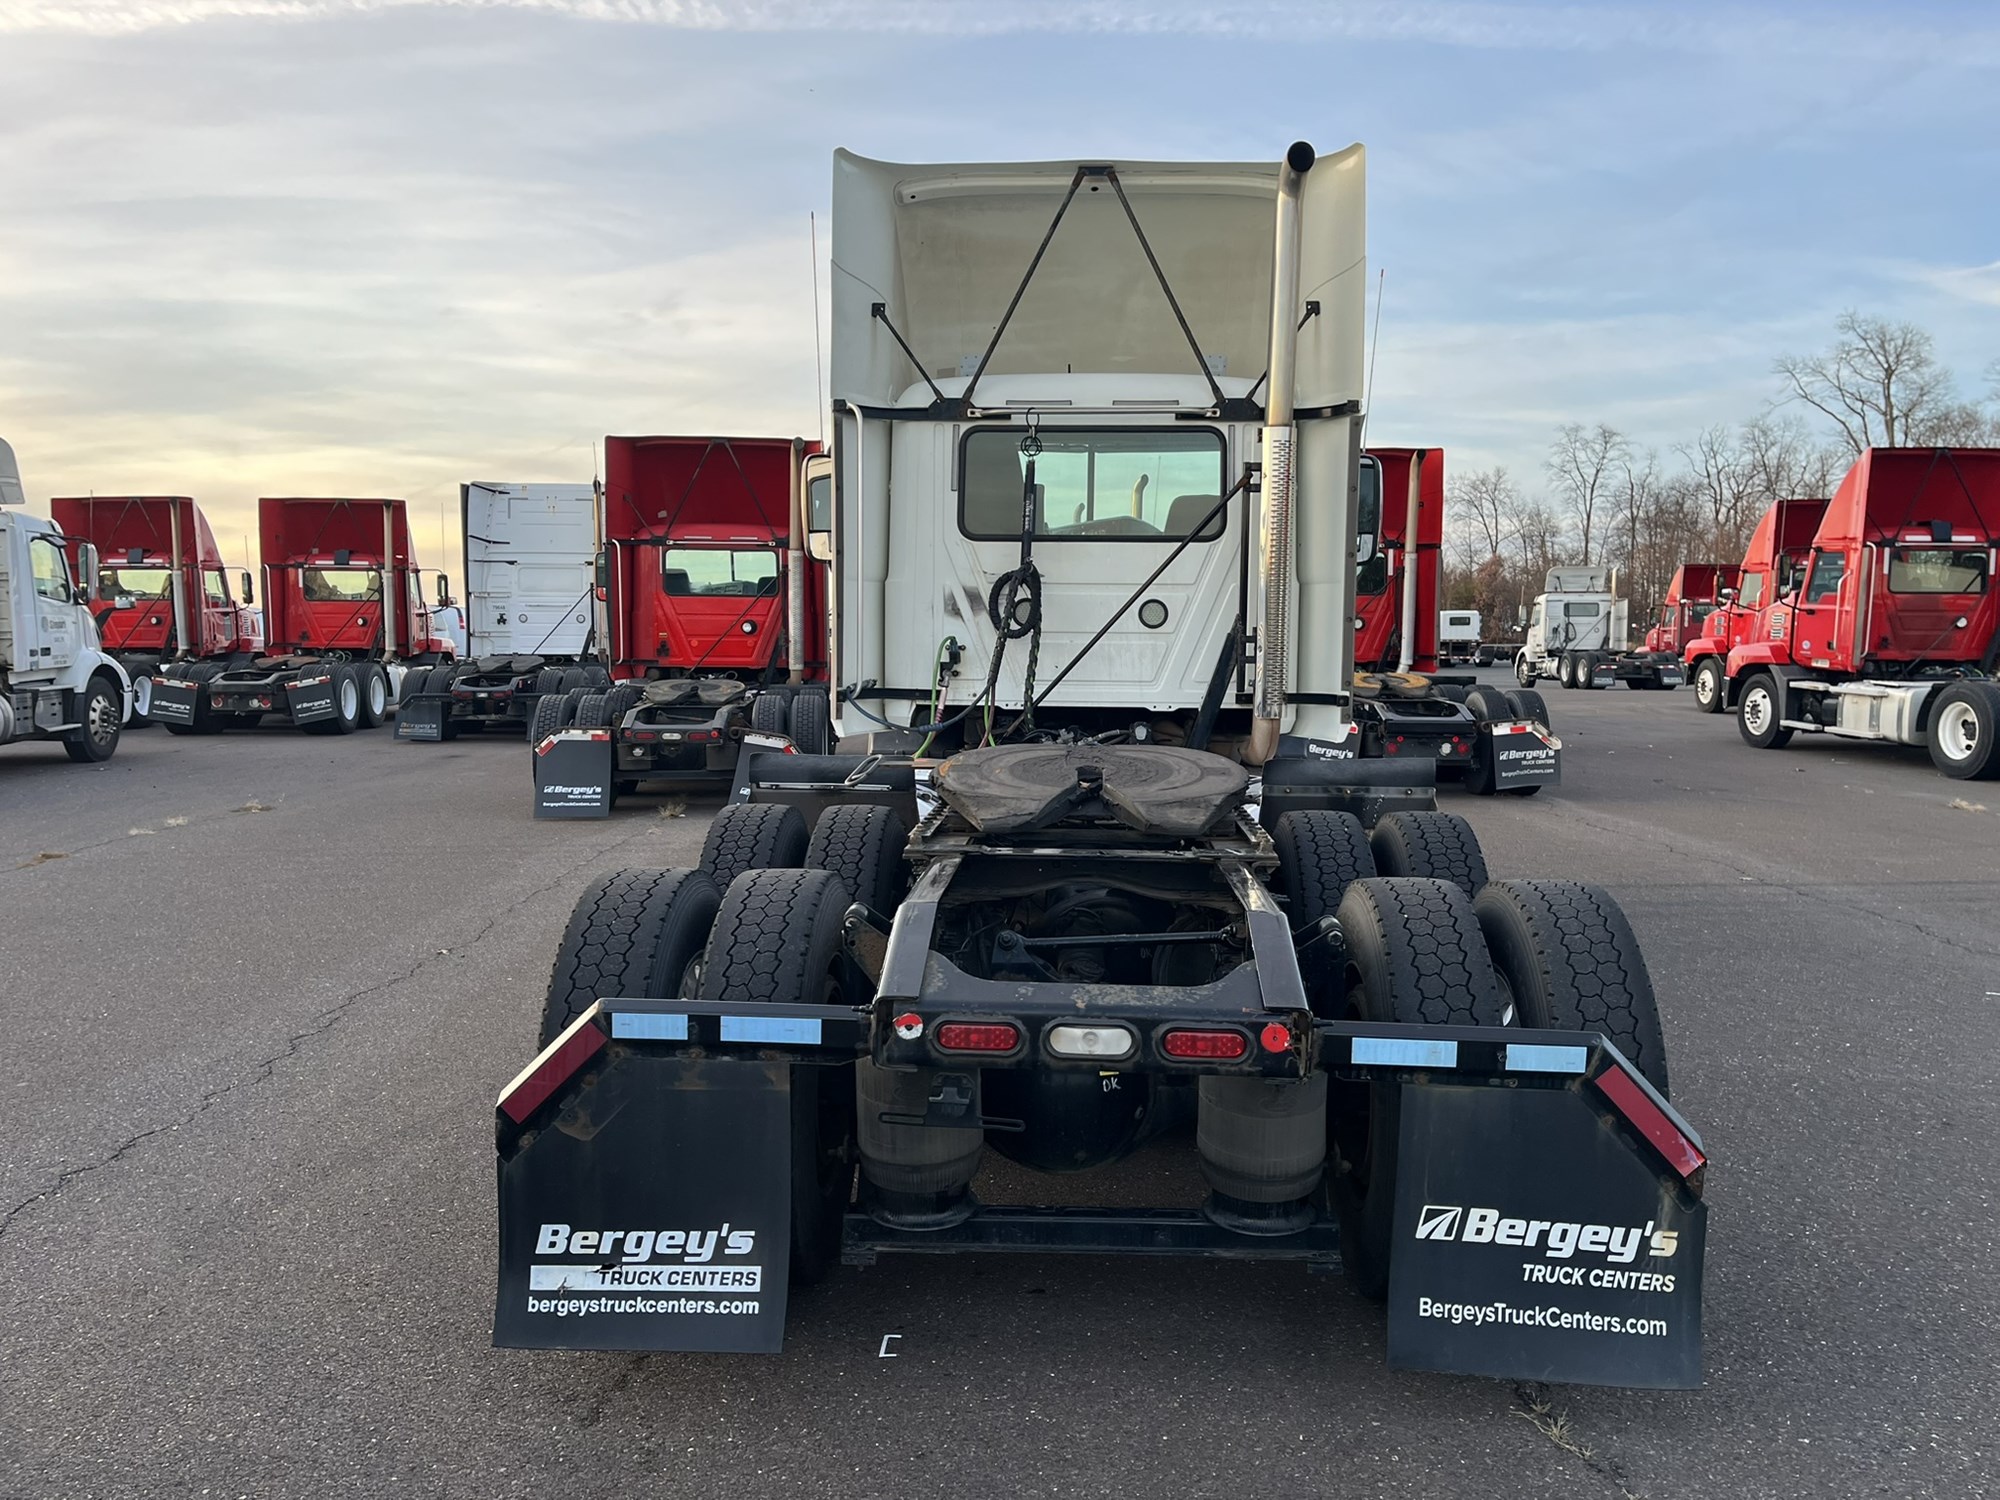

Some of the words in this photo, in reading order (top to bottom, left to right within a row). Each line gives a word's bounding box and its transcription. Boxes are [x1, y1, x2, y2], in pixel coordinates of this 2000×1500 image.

[1308, 743, 1354, 760] Bergey's
[1508, 748, 1555, 760] Bergey's
[554, 785, 602, 794] Bergey's
[535, 1223, 756, 1263] Bergey's
[1462, 1207, 1679, 1263] Bergey's
[599, 1270, 664, 1286] TRUCK
[667, 1271, 758, 1287] CENTERS
[1522, 1264, 1587, 1286] TRUCK
[1589, 1269, 1676, 1293] CENTERS
[527, 1296, 760, 1317] bergeystruckcenters.com
[1419, 1297, 1667, 1336] BergeysTruckCenters.com
